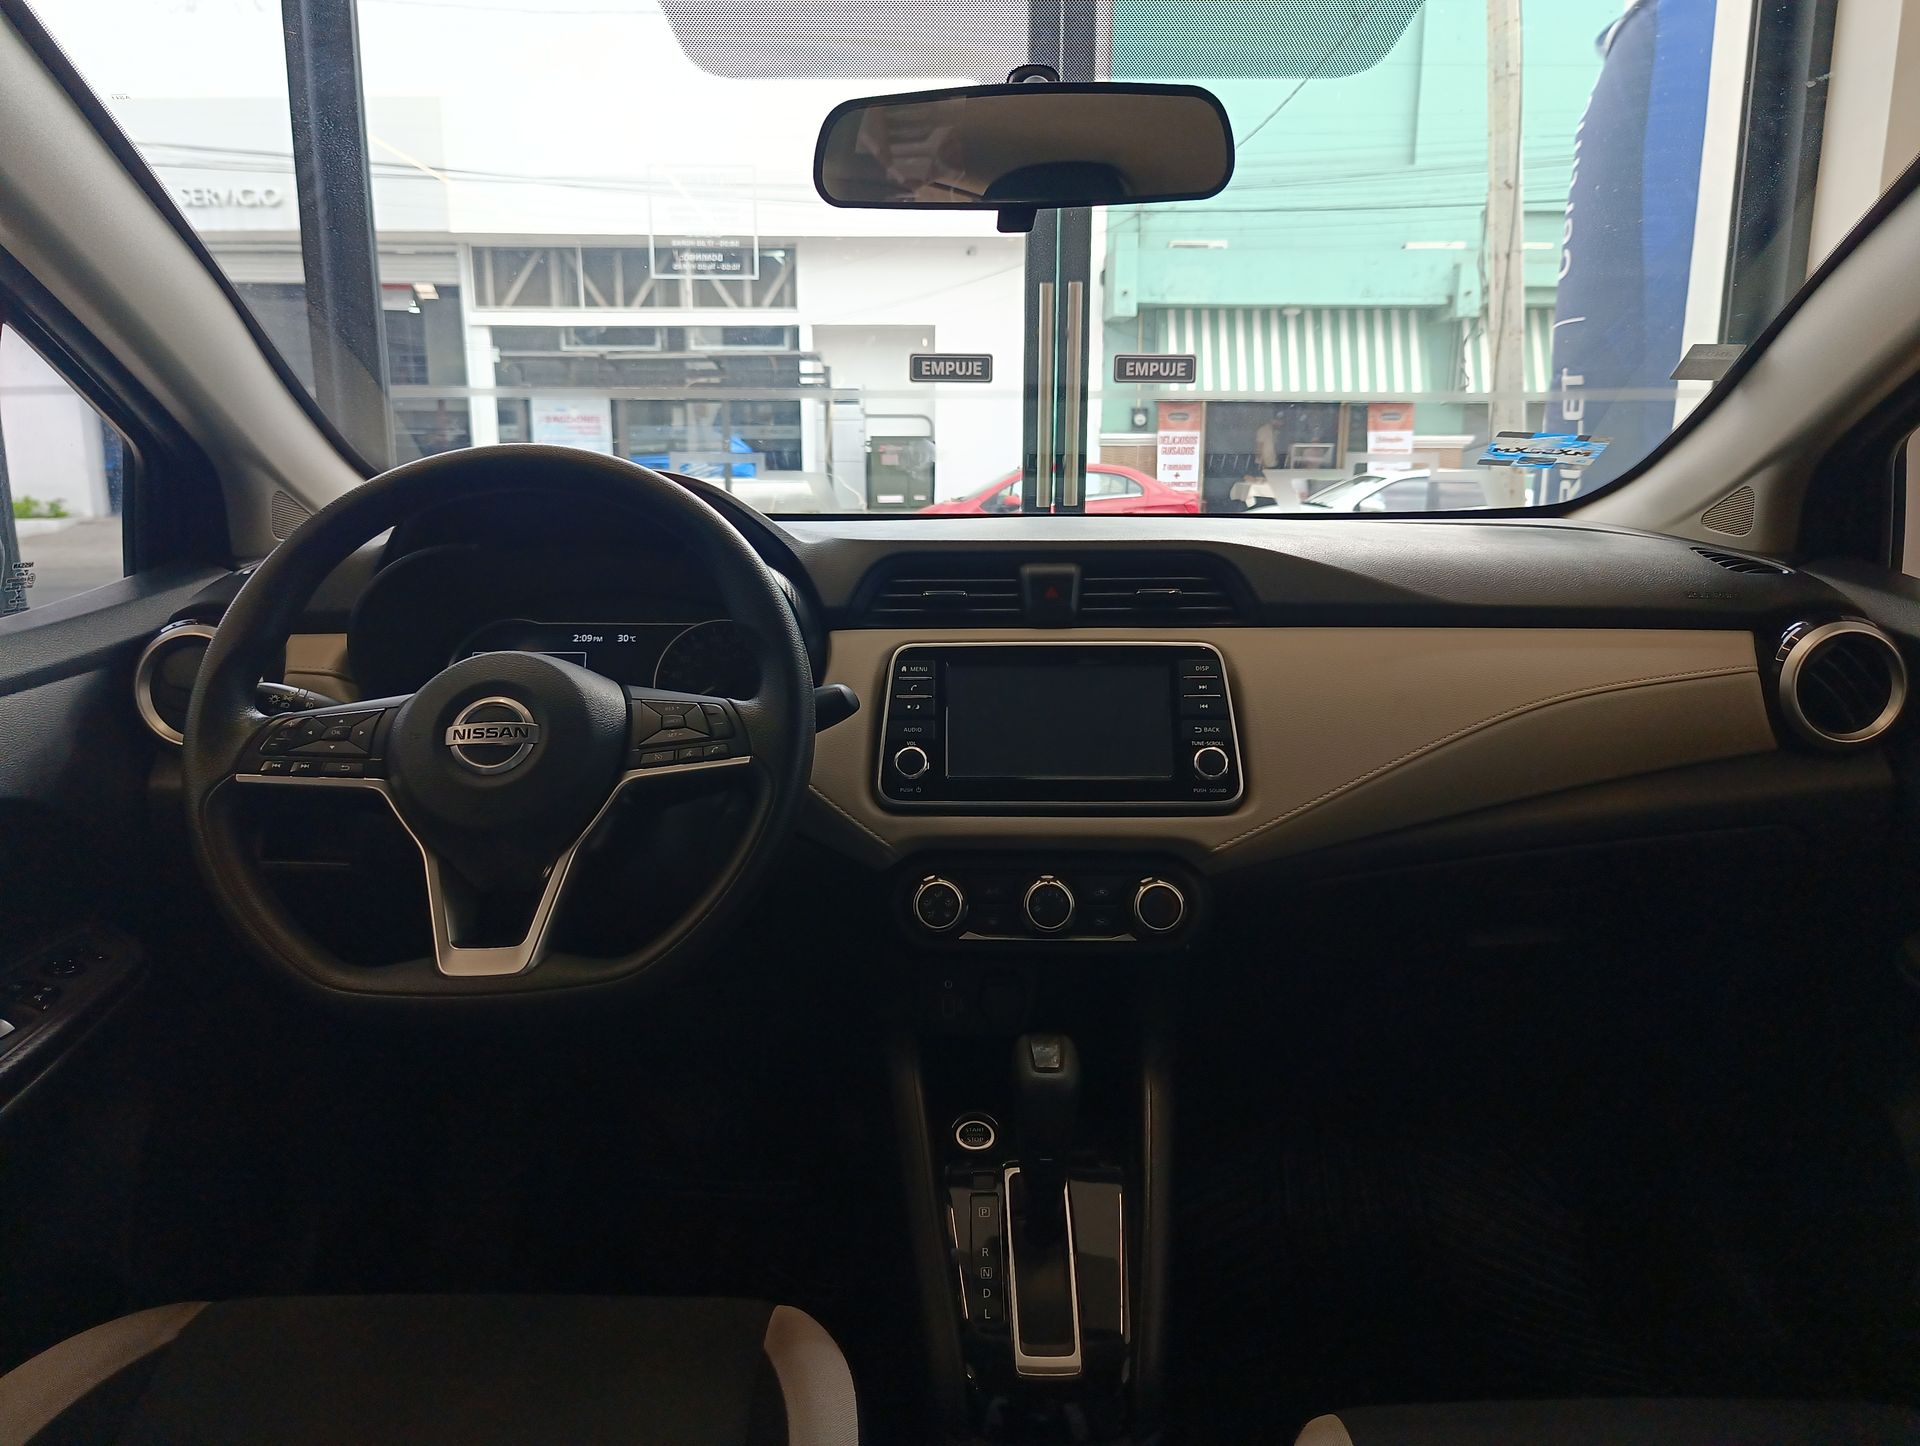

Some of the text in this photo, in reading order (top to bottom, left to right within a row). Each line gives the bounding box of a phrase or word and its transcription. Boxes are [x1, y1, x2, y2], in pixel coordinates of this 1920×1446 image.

[921, 360, 983, 377] EMPUJE
[1125, 361, 1186, 377] EMPUJE
[452, 726, 529, 741] NISSAN
[982, 1247, 989, 1257] R
[983, 1288, 991, 1298] D
[985, 1309, 991, 1319] L
